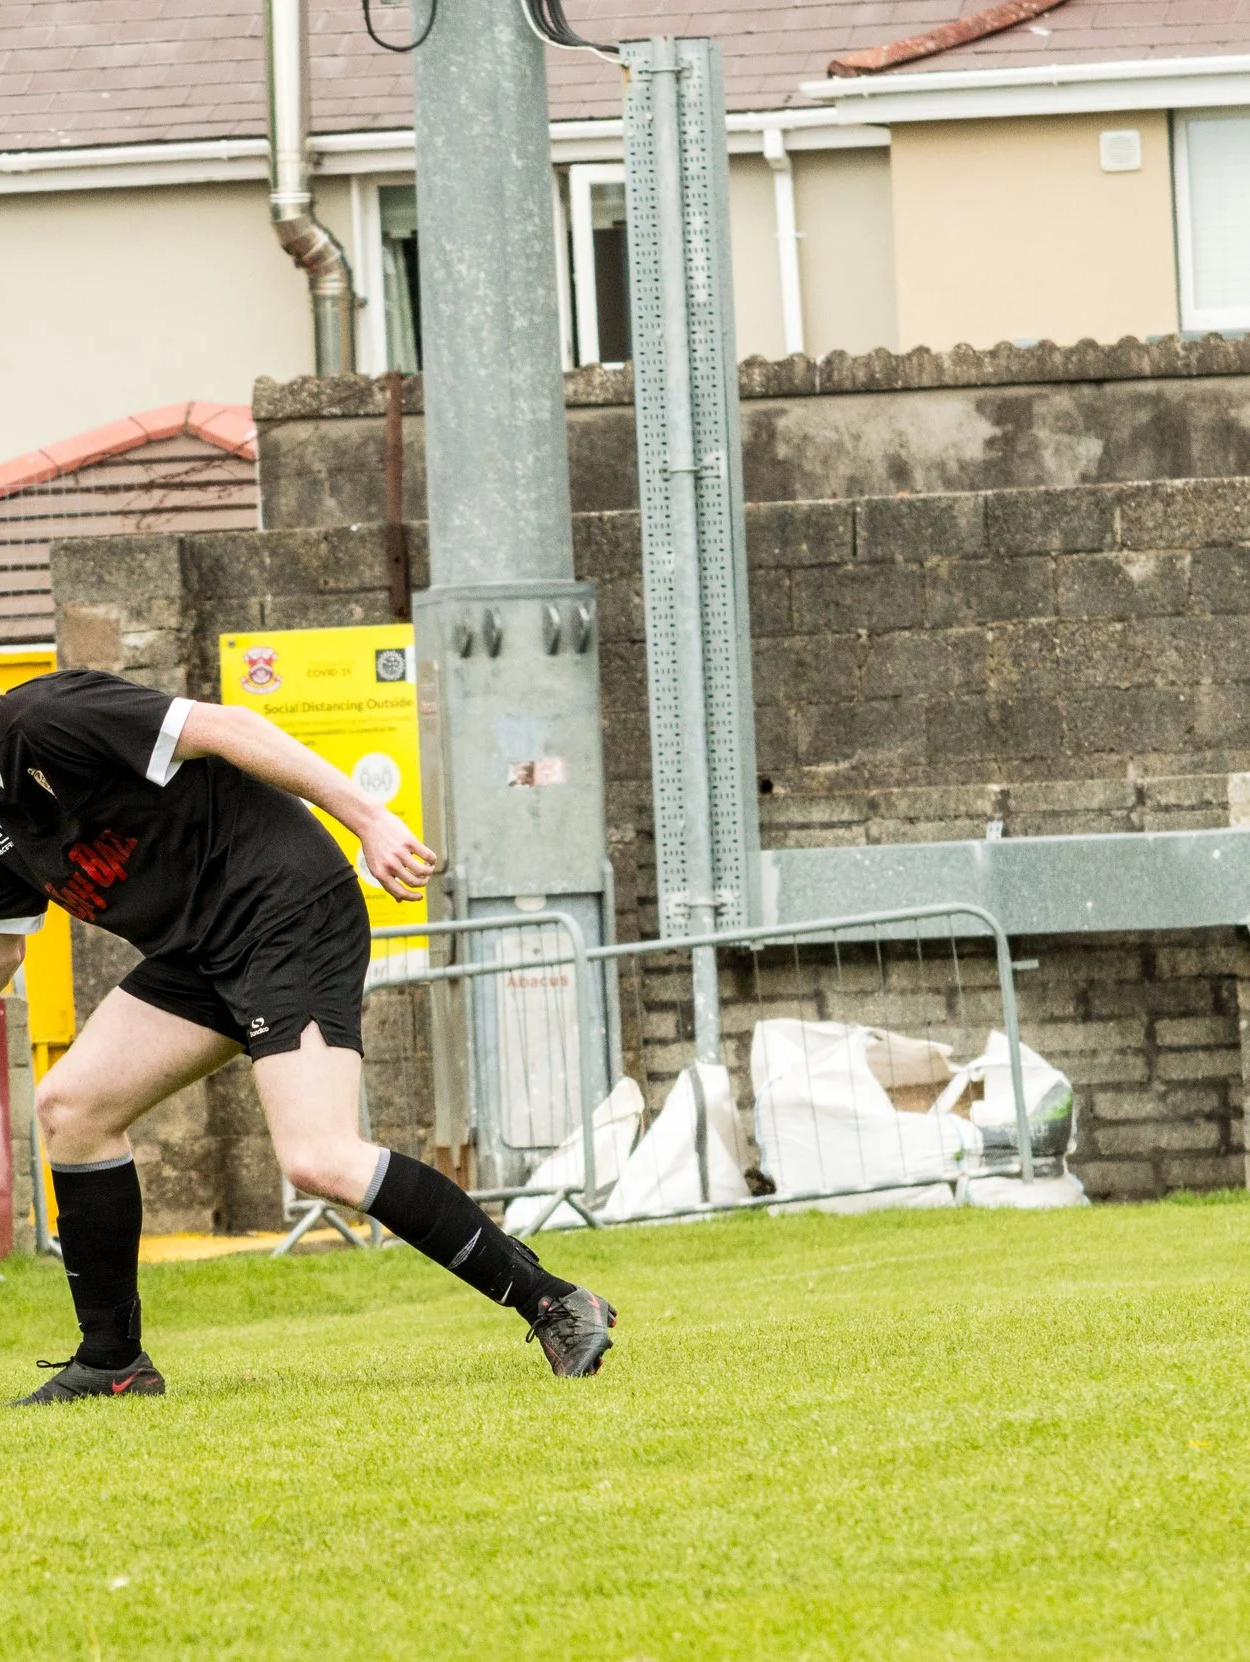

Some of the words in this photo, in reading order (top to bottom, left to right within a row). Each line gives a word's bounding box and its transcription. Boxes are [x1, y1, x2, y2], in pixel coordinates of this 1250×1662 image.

[264, 703, 299, 715] Social
[302, 700, 364, 713] Distancing
[367, 697, 413, 710] Outside
